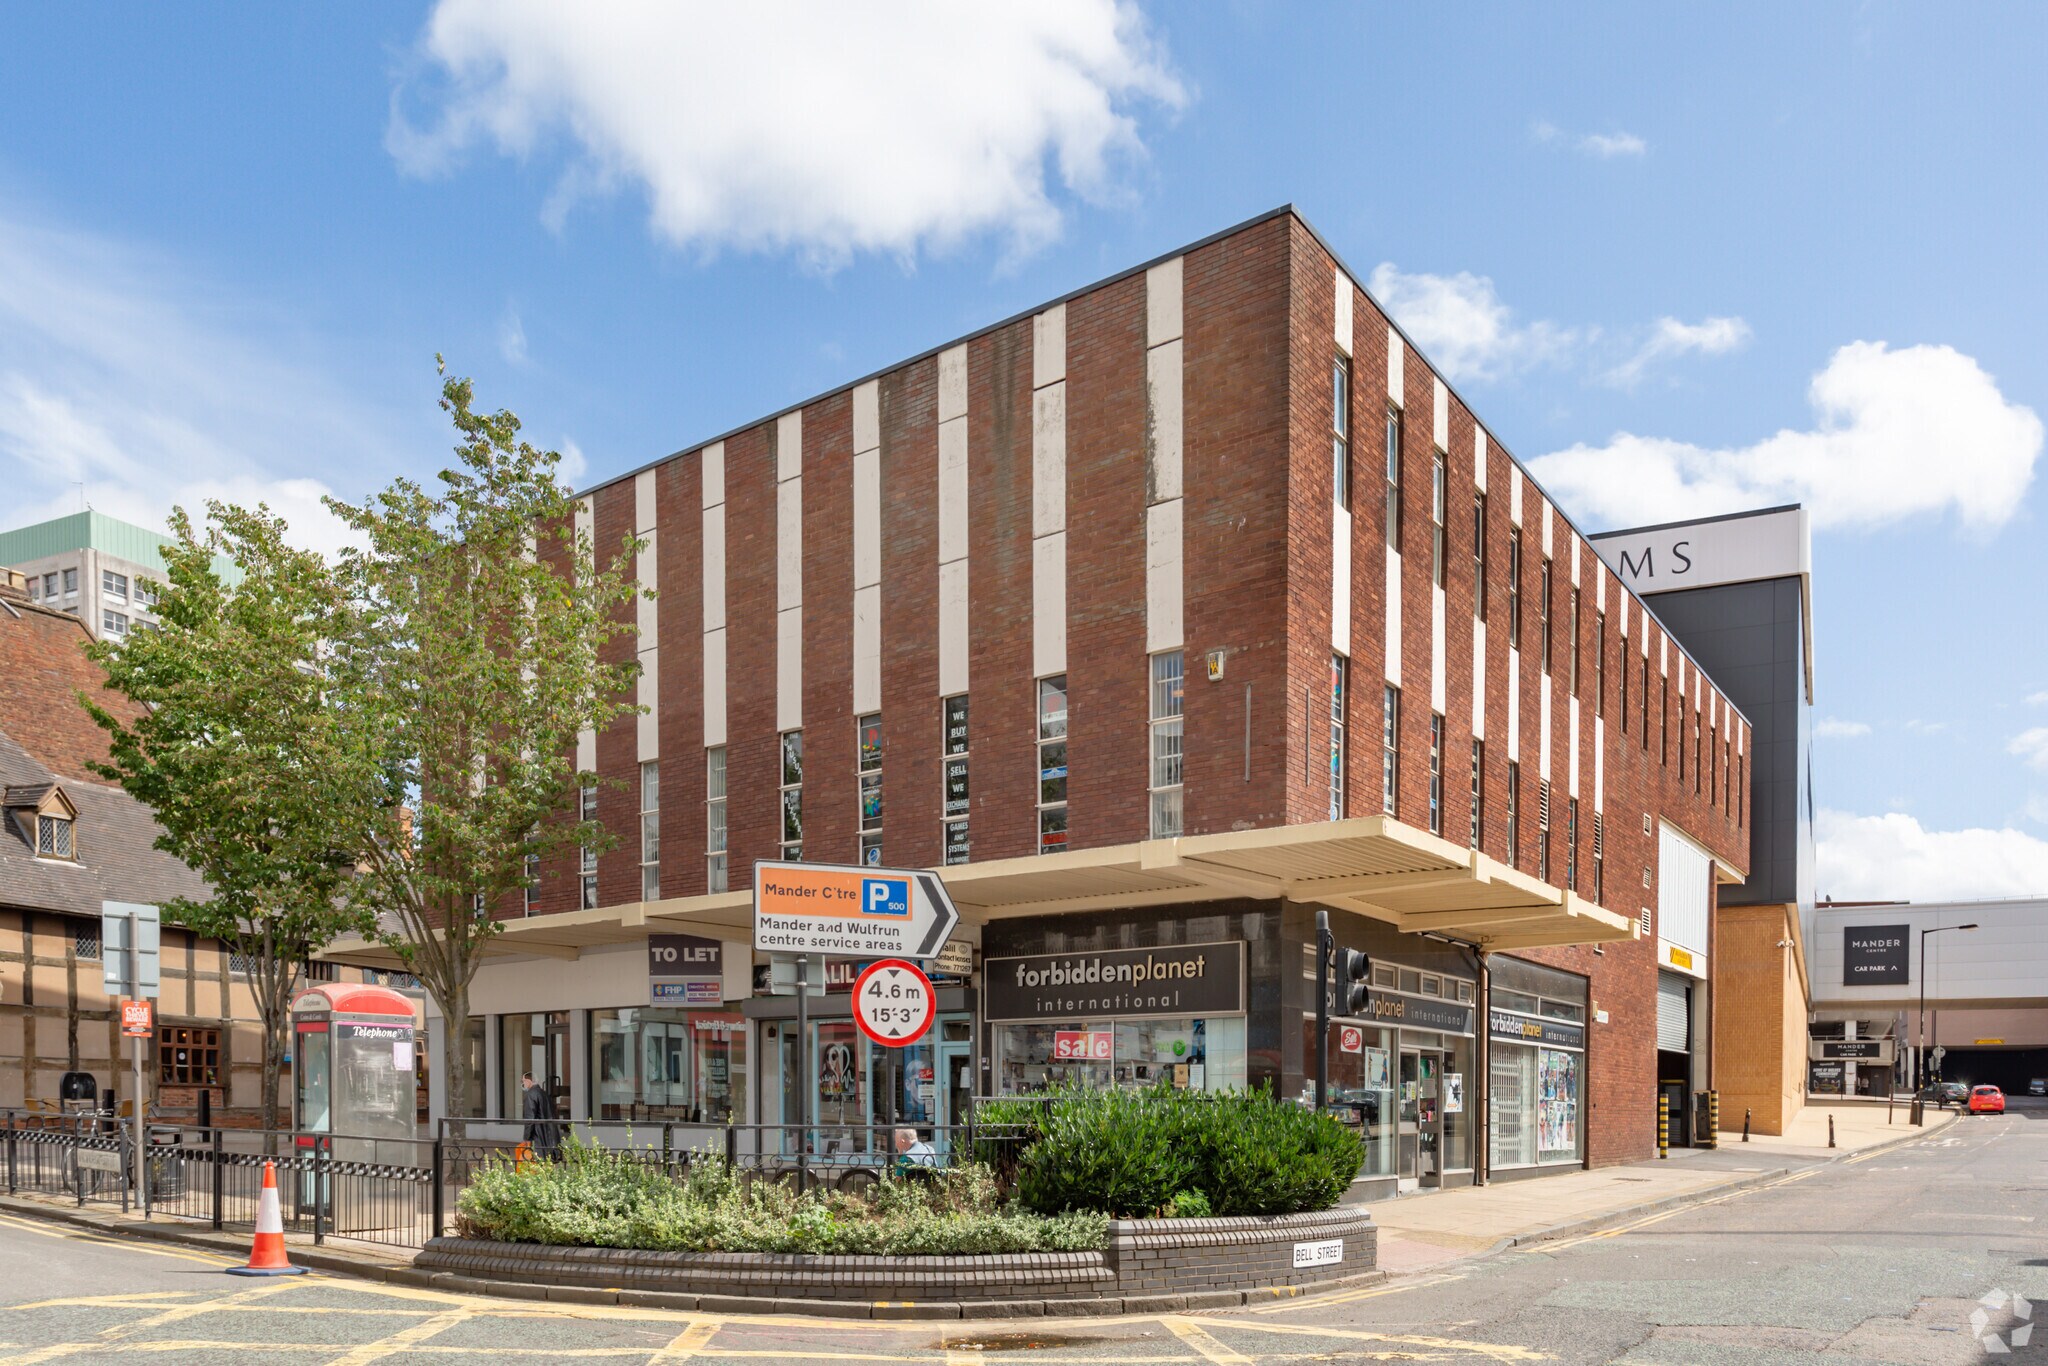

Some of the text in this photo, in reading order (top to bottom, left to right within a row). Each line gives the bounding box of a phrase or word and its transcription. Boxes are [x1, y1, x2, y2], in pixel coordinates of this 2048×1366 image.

[952, 711, 964, 720] WE
[951, 726, 966, 736] BUY
[952, 744, 964, 753] WE
[950, 765, 966, 775] SELL
[952, 783, 964, 792] WE
[950, 822, 968, 831] GAMES
[765, 883, 817, 898] Mander
[869, 882, 890, 911] P
[888, 902, 905, 911] 500
[760, 917, 900, 936] Mander and Wulfrun
[760, 934, 902, 951] centre service areas
[1852, 939, 1901, 948] MANDER
[651, 947, 719, 962] TO LET
[664, 986, 683, 994] FHP
[868, 980, 920, 999] 4.6 m
[1036, 990, 1180, 1012] international
[1411, 1006, 1464, 1026] international
[353, 1026, 398, 1039] Telephone
[1058, 1033, 1109, 1057] sale
[1295, 1244, 1342, 1262] BELL STREET
